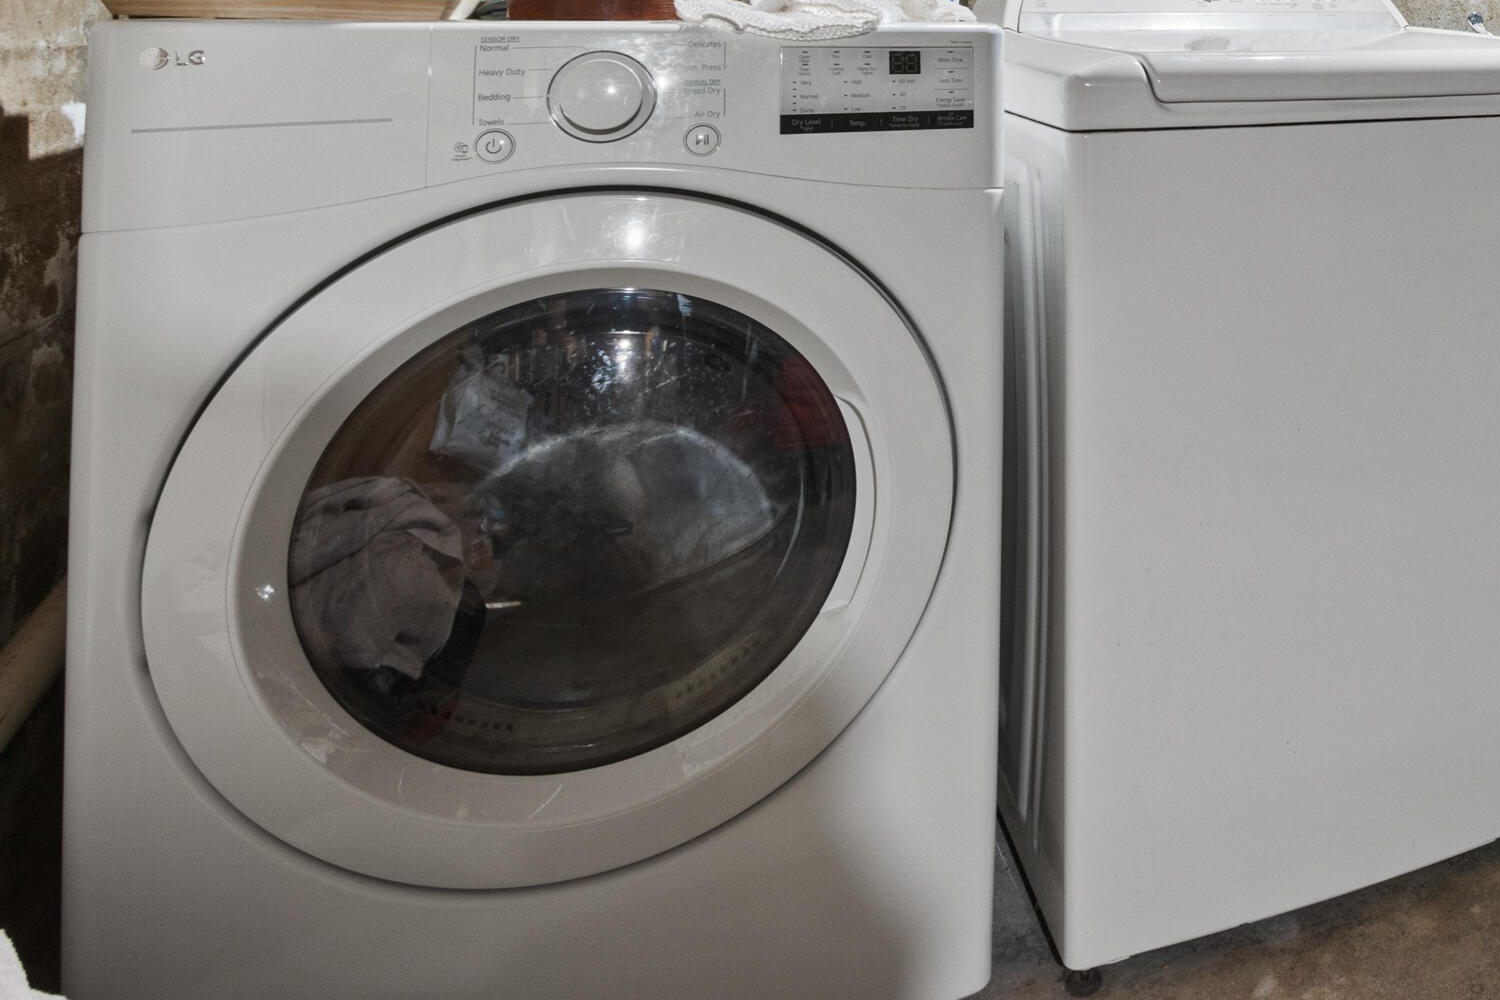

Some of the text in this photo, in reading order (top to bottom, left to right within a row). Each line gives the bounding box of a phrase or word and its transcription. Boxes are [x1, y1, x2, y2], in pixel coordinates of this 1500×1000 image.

[480, 44, 509, 52] Normal
[176, 49, 206, 66] LG
[479, 68, 526, 77] Heavy Duty
[478, 93, 511, 102] Bedding
[708, 111, 721, 119] Dry
